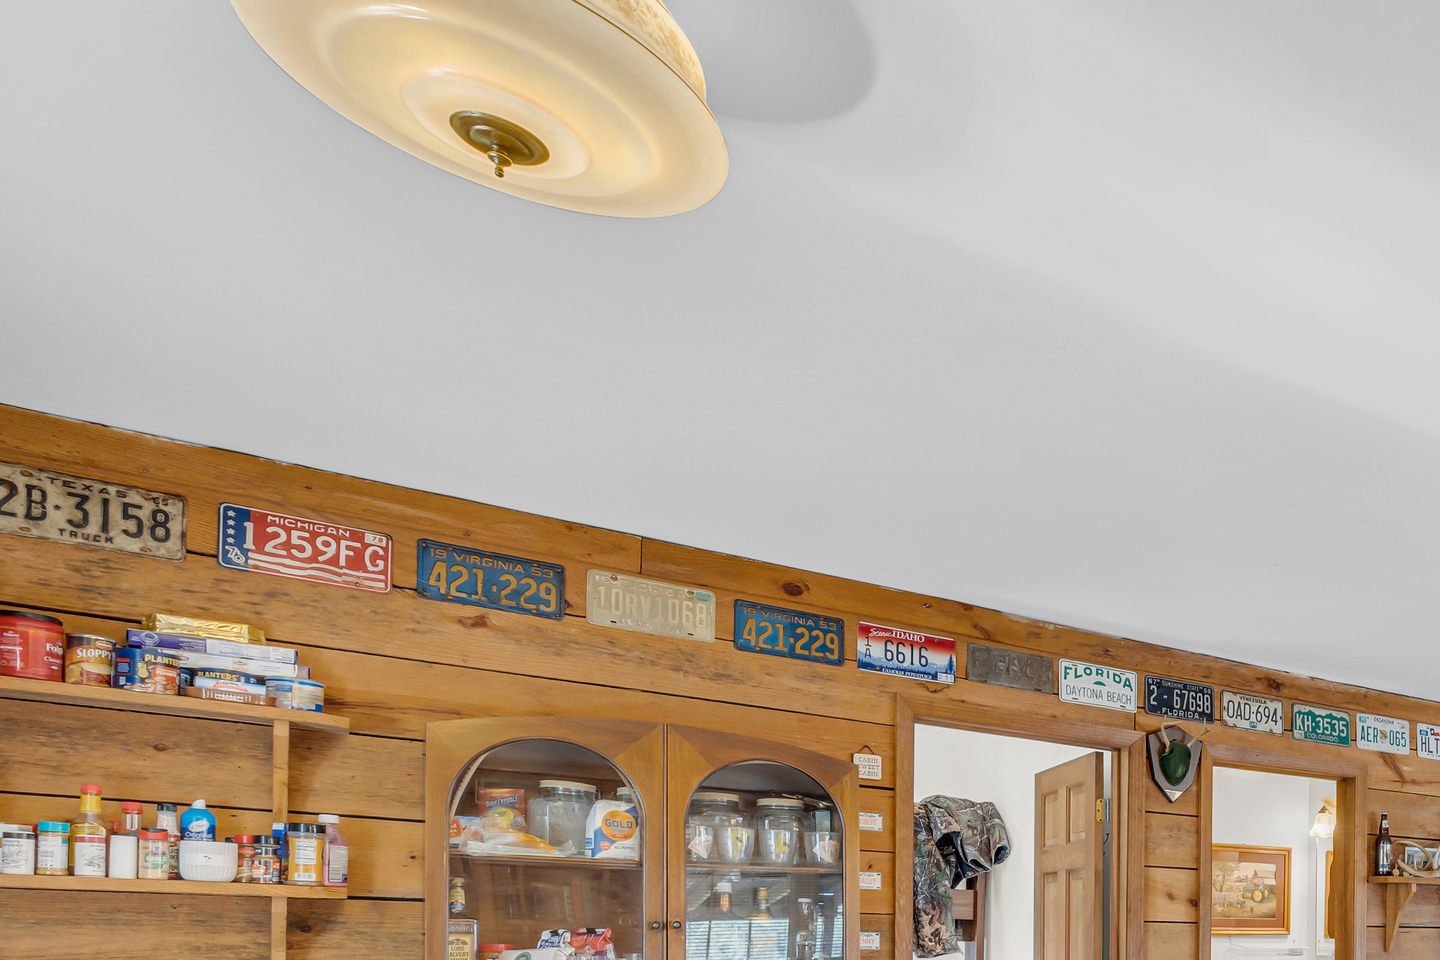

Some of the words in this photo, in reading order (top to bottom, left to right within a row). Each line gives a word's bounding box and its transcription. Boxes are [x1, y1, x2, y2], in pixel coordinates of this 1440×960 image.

[47, 477, 127, 498] TEXAS
[267, 515, 350, 538] MICHIGAN
[58, 528, 114, 545] TRUCK
[225, 545, 246, 564] 76
[430, 547, 448, 560] 19
[453, 550, 524, 573] VIRGINIA
[530, 564, 555, 579] 53
[743, 606, 758, 617] 19
[762, 609, 815, 626] VIRGINIA
[819, 618, 838, 631] 53
[892, 630, 925, 643] IDAHO
[77, 647, 113, 660] SLOPPY
[884, 639, 929, 668] 6616
[882, 667, 905, 676] FAMOUS
[1063, 665, 1134, 692] FLORIDA
[1065, 683, 1103, 700] DAYTONA
[1106, 690, 1132, 706] BEACH
[1162, 680, 1184, 689] SUNSHINE
[1186, 684, 1199, 692] STATE
[1239, 695, 1267, 705] VENEZUELA
[1161, 707, 1200, 720] FLORIDA
[1306, 732, 1339, 742] COLORADO
[1361, 725, 1378, 743] AER
[1389, 730, 1406, 747] 065
[605, 817, 634, 829] GOLD
